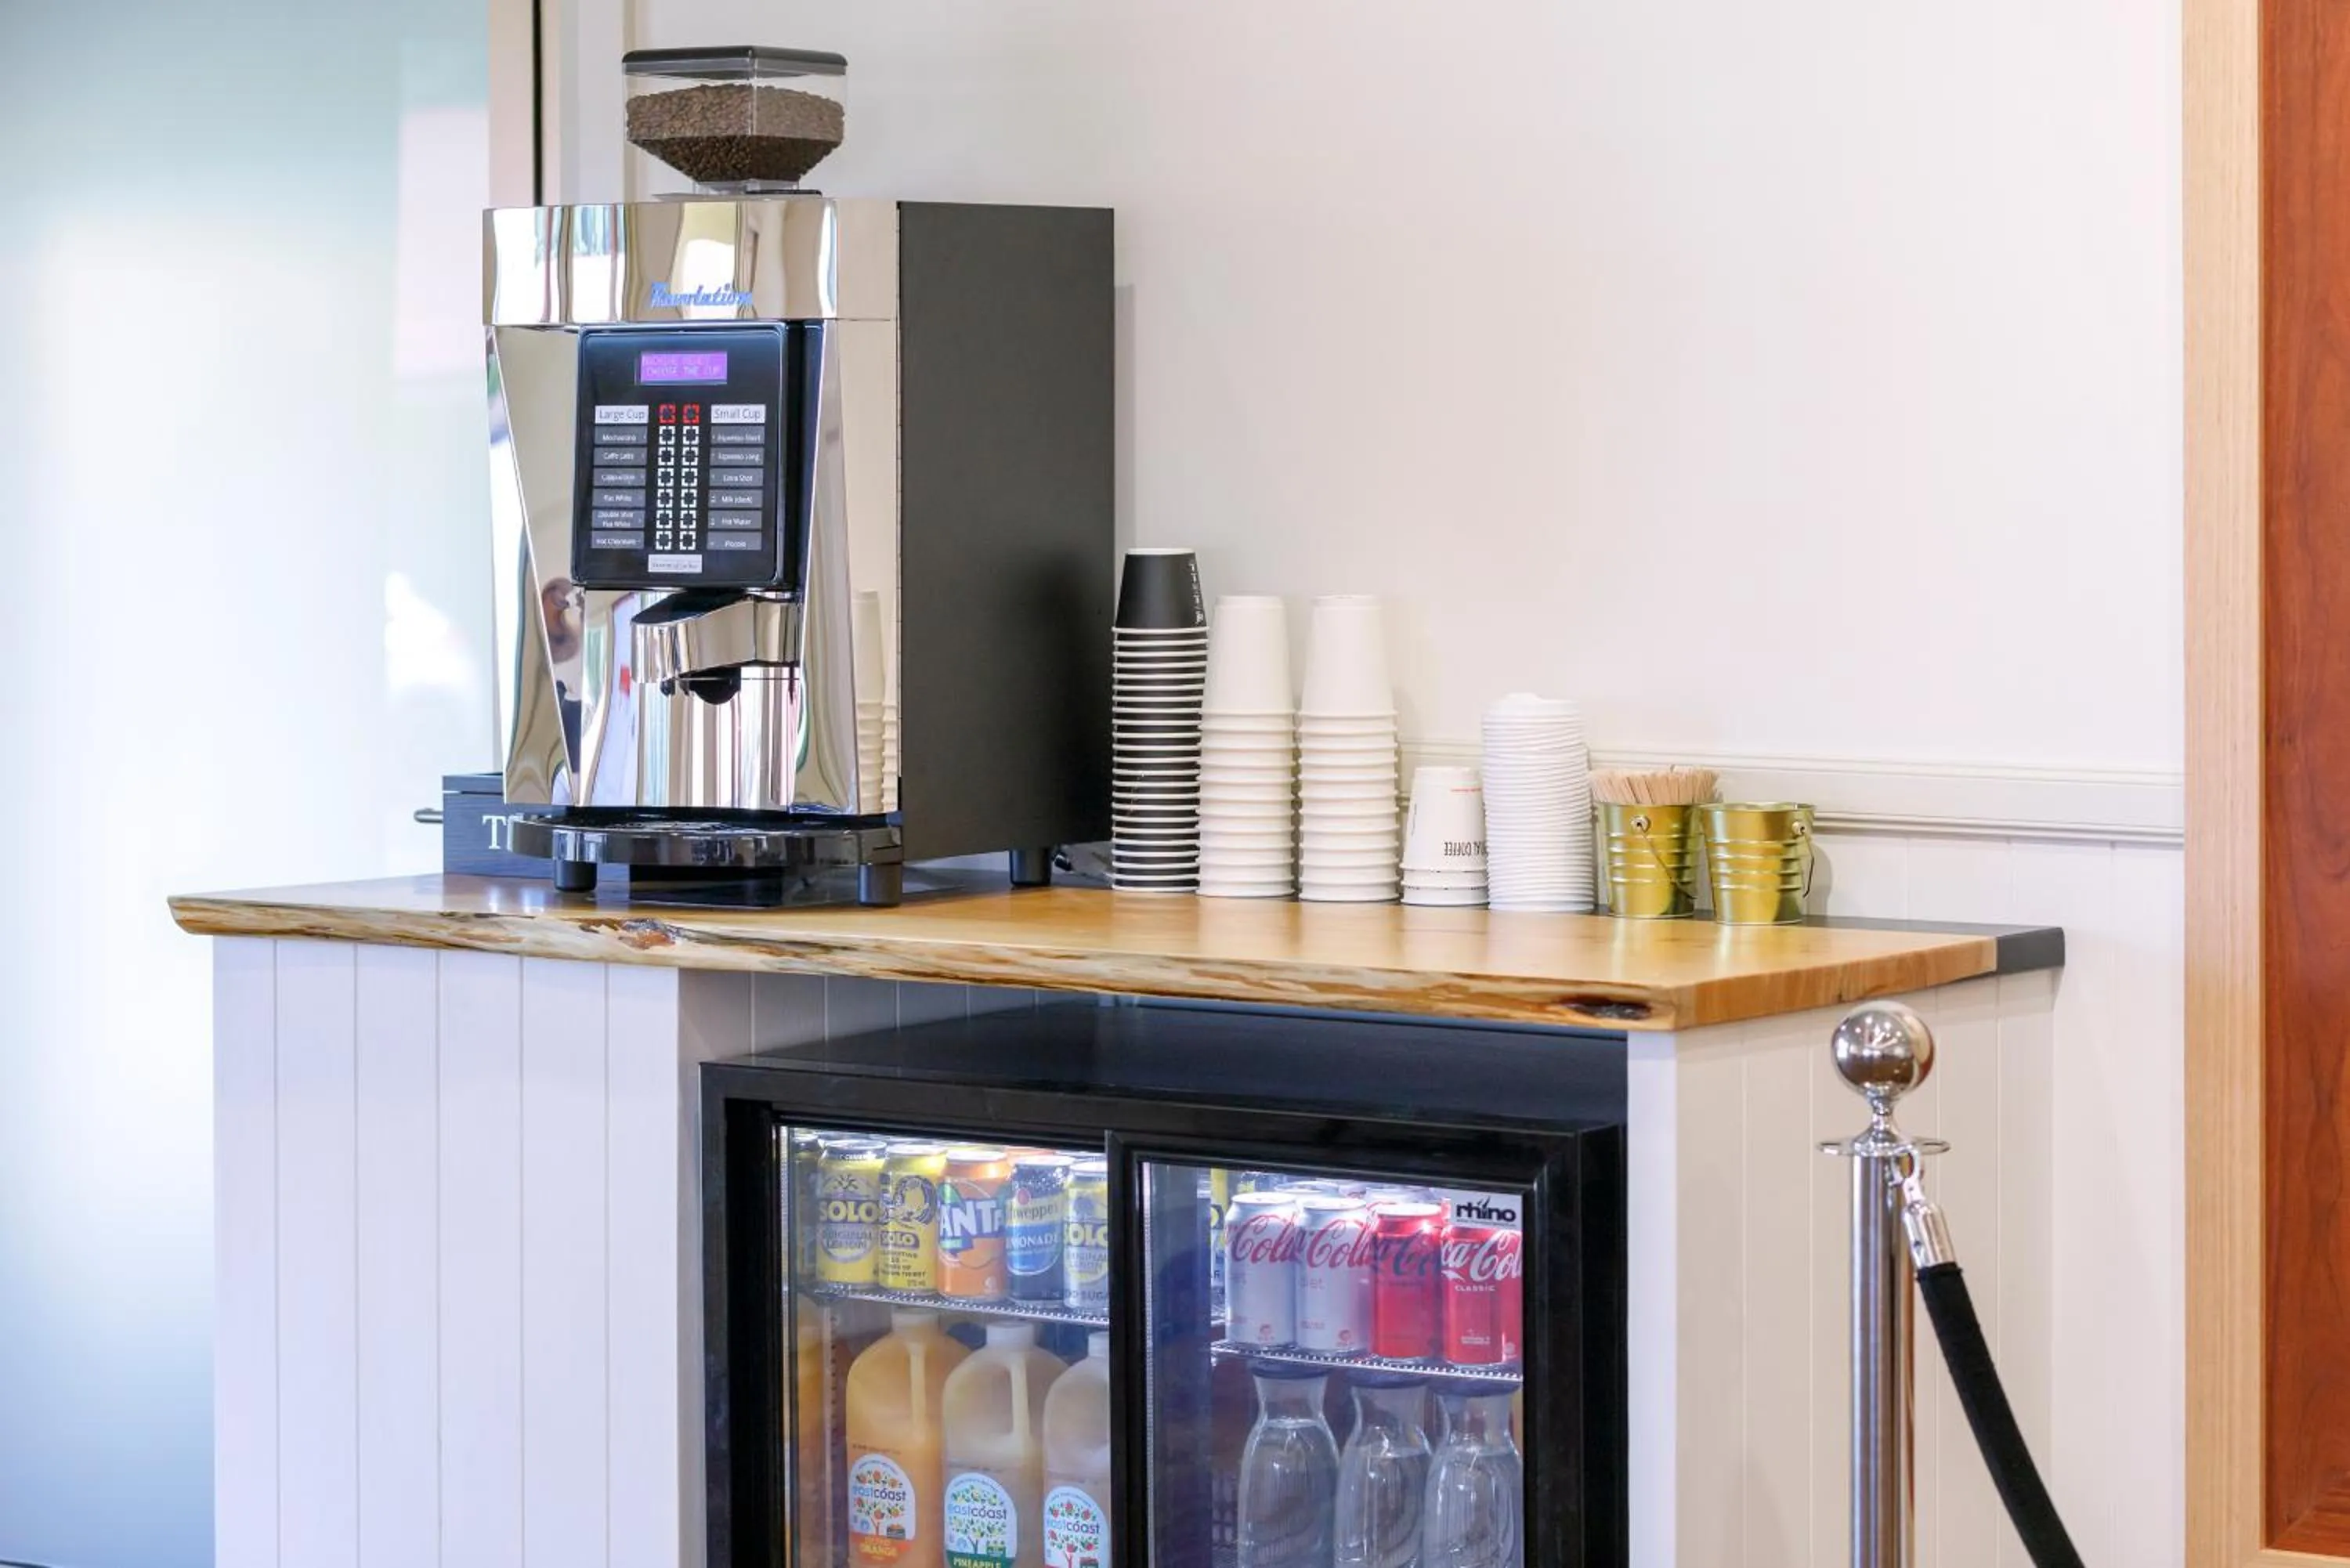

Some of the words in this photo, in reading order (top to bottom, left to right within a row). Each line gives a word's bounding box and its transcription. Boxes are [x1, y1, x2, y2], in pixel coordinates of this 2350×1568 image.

[599, 410, 624, 421] Large
[626, 409, 645, 421] Cup
[714, 408, 740, 419] Small
[742, 408, 761, 421] Cup
[1444, 840, 1472, 856] COFFEE
[819, 1200, 879, 1223] SOLO
[1456, 1196, 1517, 1223] rhino
[881, 1233, 915, 1246] SOLO
